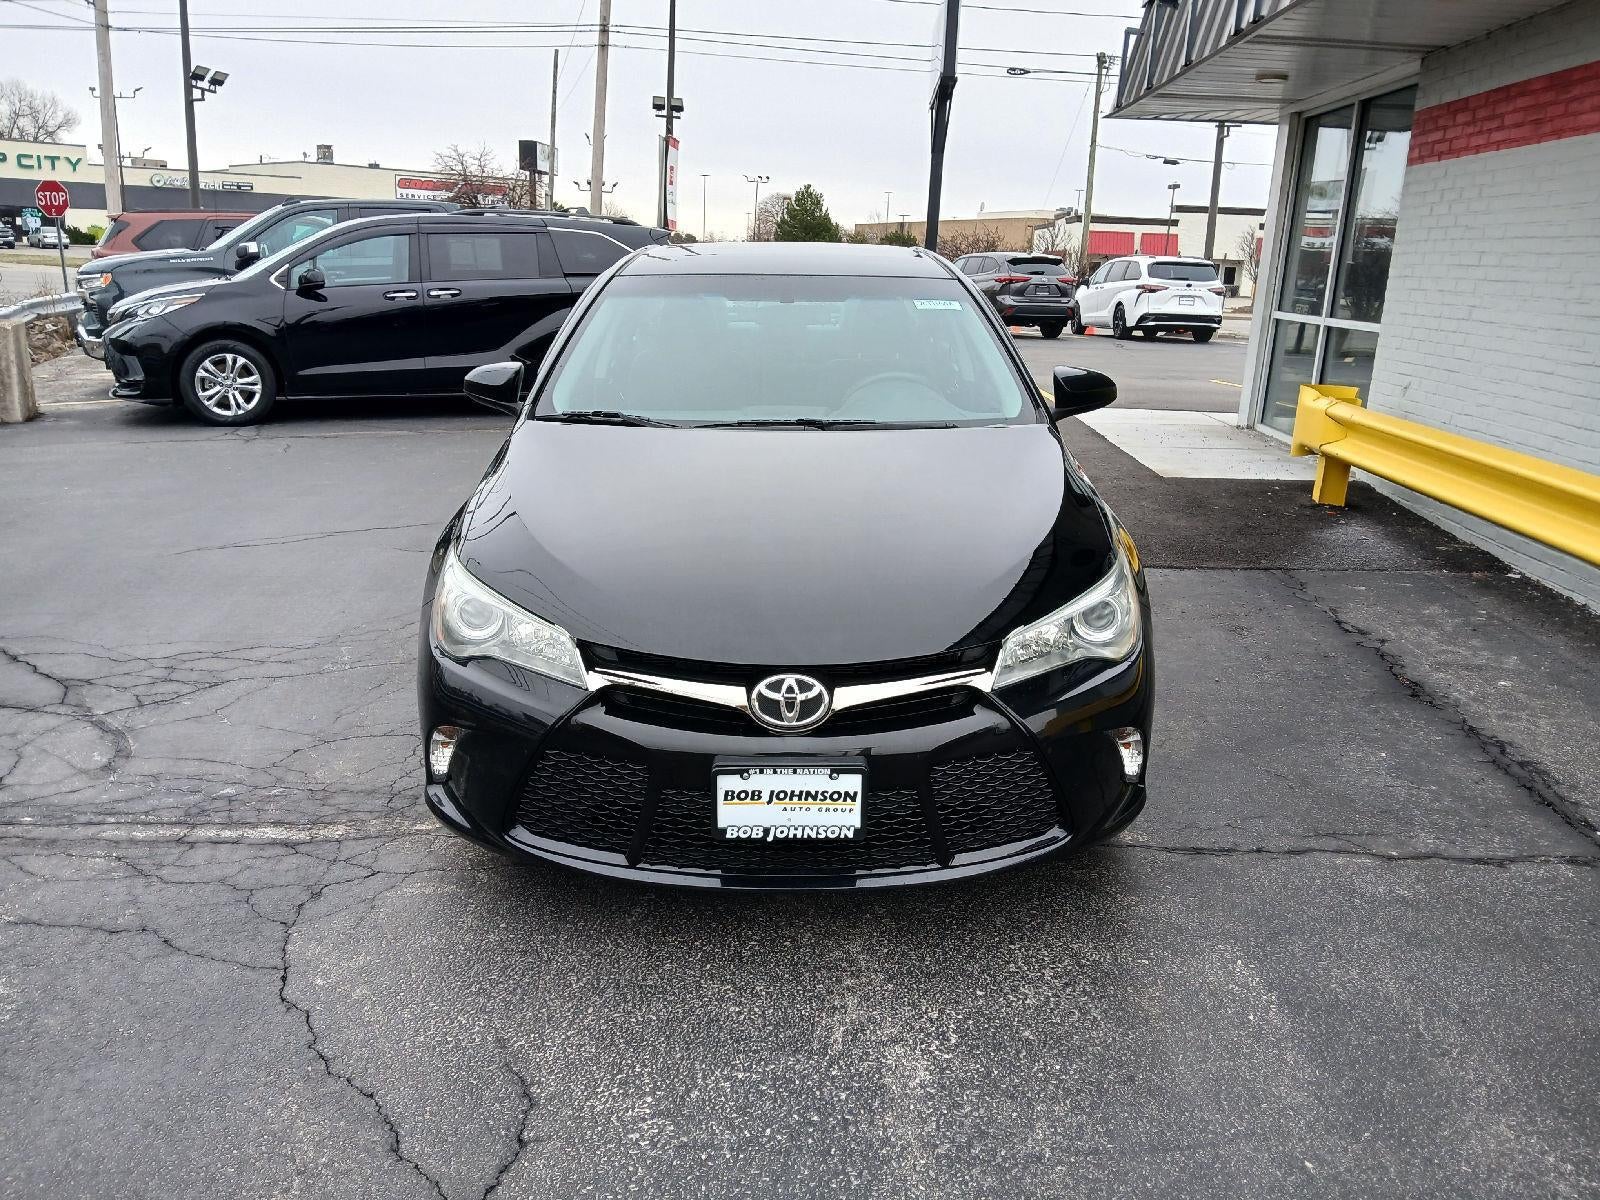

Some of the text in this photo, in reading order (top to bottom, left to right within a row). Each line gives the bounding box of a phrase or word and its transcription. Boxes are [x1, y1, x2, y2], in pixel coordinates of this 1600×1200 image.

[16, 153, 83, 173] CITY
[37, 191, 66, 206] STOP
[723, 789, 858, 805] BOB JOHNSON
[817, 806, 855, 814] GROUP
[726, 825, 855, 842] BOB JOHNSON
